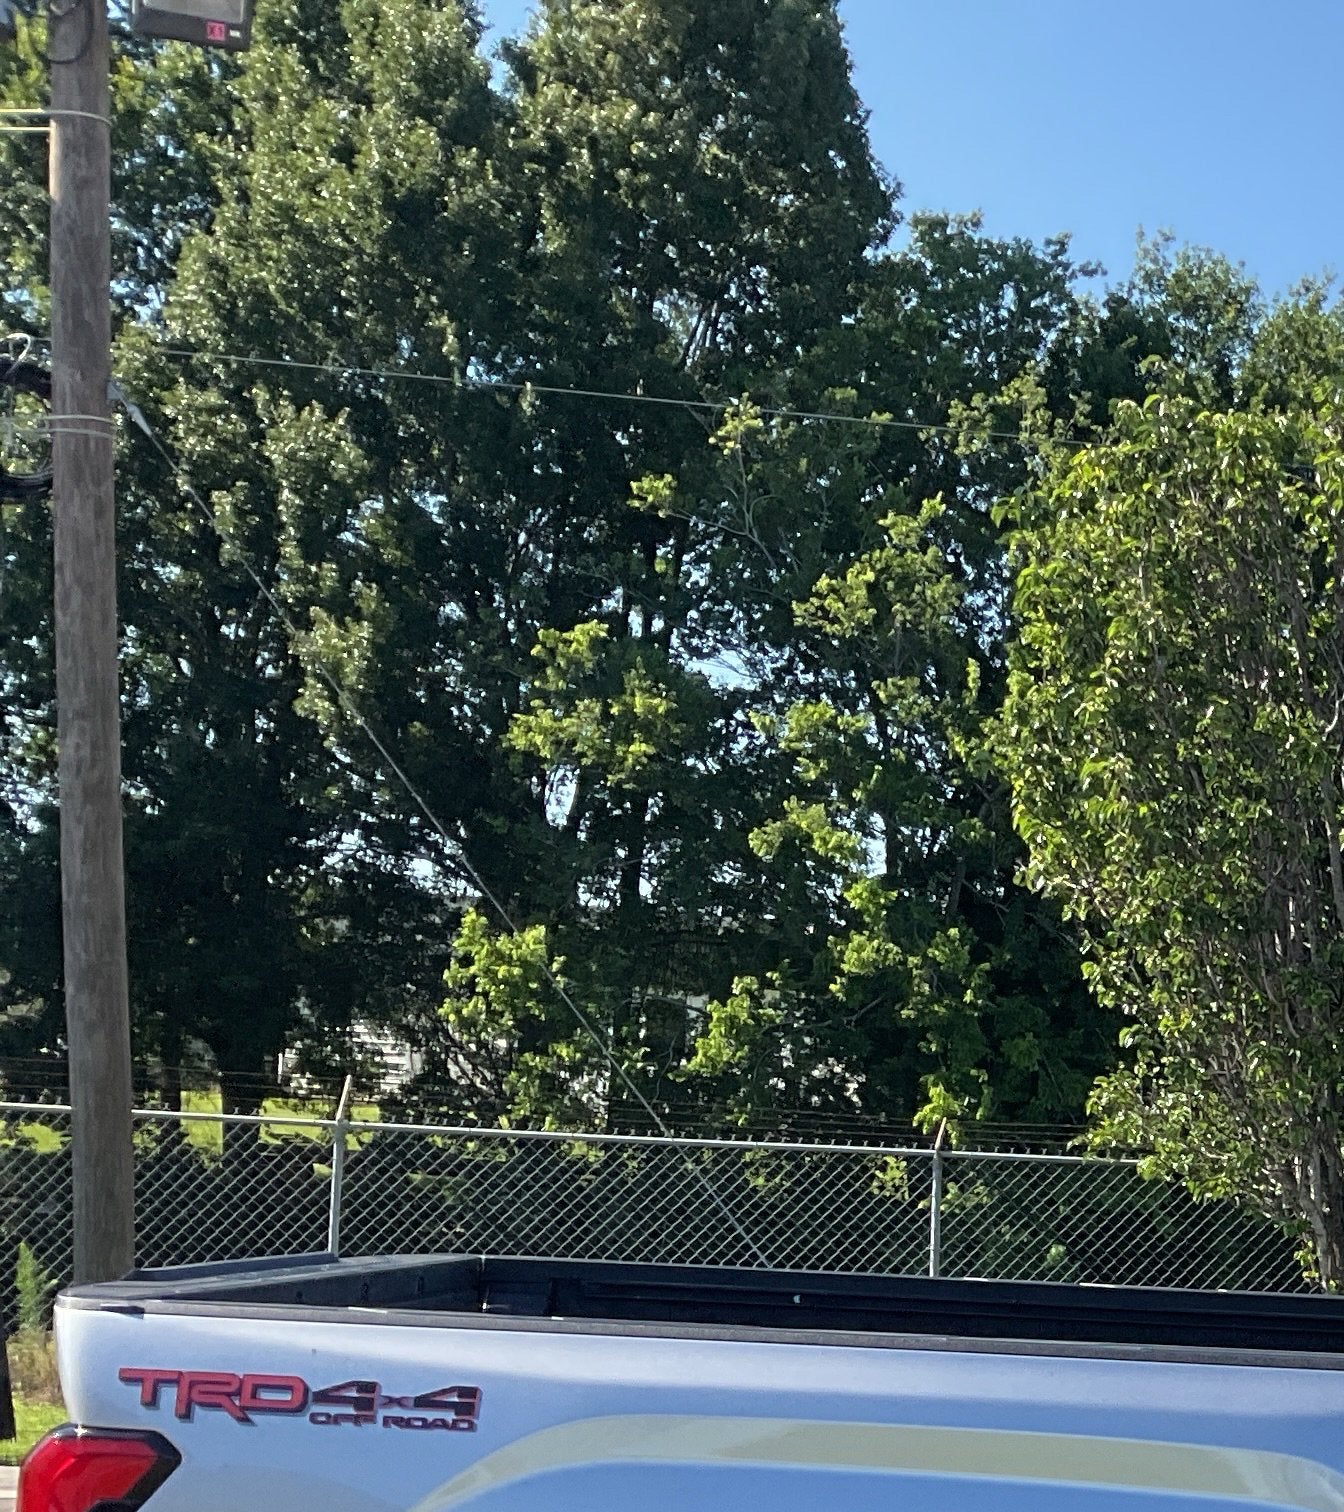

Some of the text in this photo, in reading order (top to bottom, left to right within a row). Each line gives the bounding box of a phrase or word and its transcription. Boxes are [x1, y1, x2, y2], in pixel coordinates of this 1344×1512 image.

[119, 1367, 310, 1427] TRD
[309, 1411, 478, 1433] OFF ROAD
